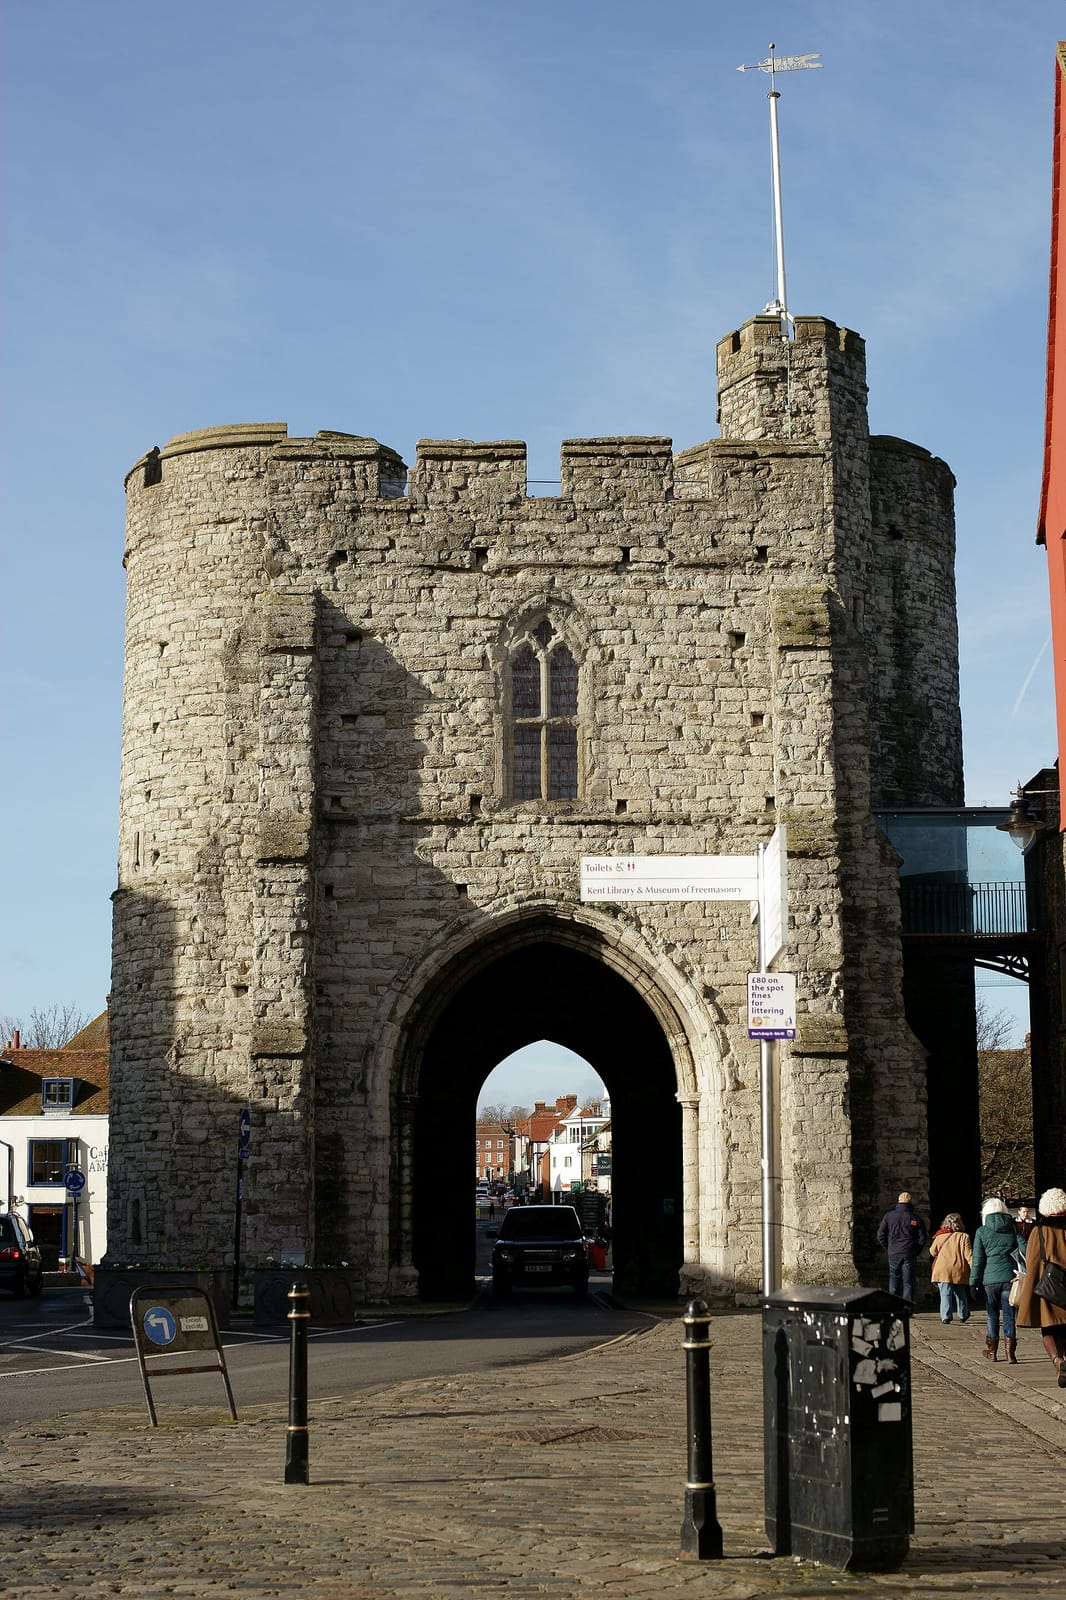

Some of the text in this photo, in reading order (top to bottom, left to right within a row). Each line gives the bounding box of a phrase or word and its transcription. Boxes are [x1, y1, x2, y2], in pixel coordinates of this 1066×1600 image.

[585, 863, 612, 872] Toilets
[587, 887, 605, 895] Kent
[607, 886, 635, 896] Library
[645, 886, 680, 894] Museum
[681, 885, 690, 894] of
[691, 885, 742, 896] Freemasonry
[751, 1007, 784, 1015] littering
[88, 1161, 107, 1172] AM
